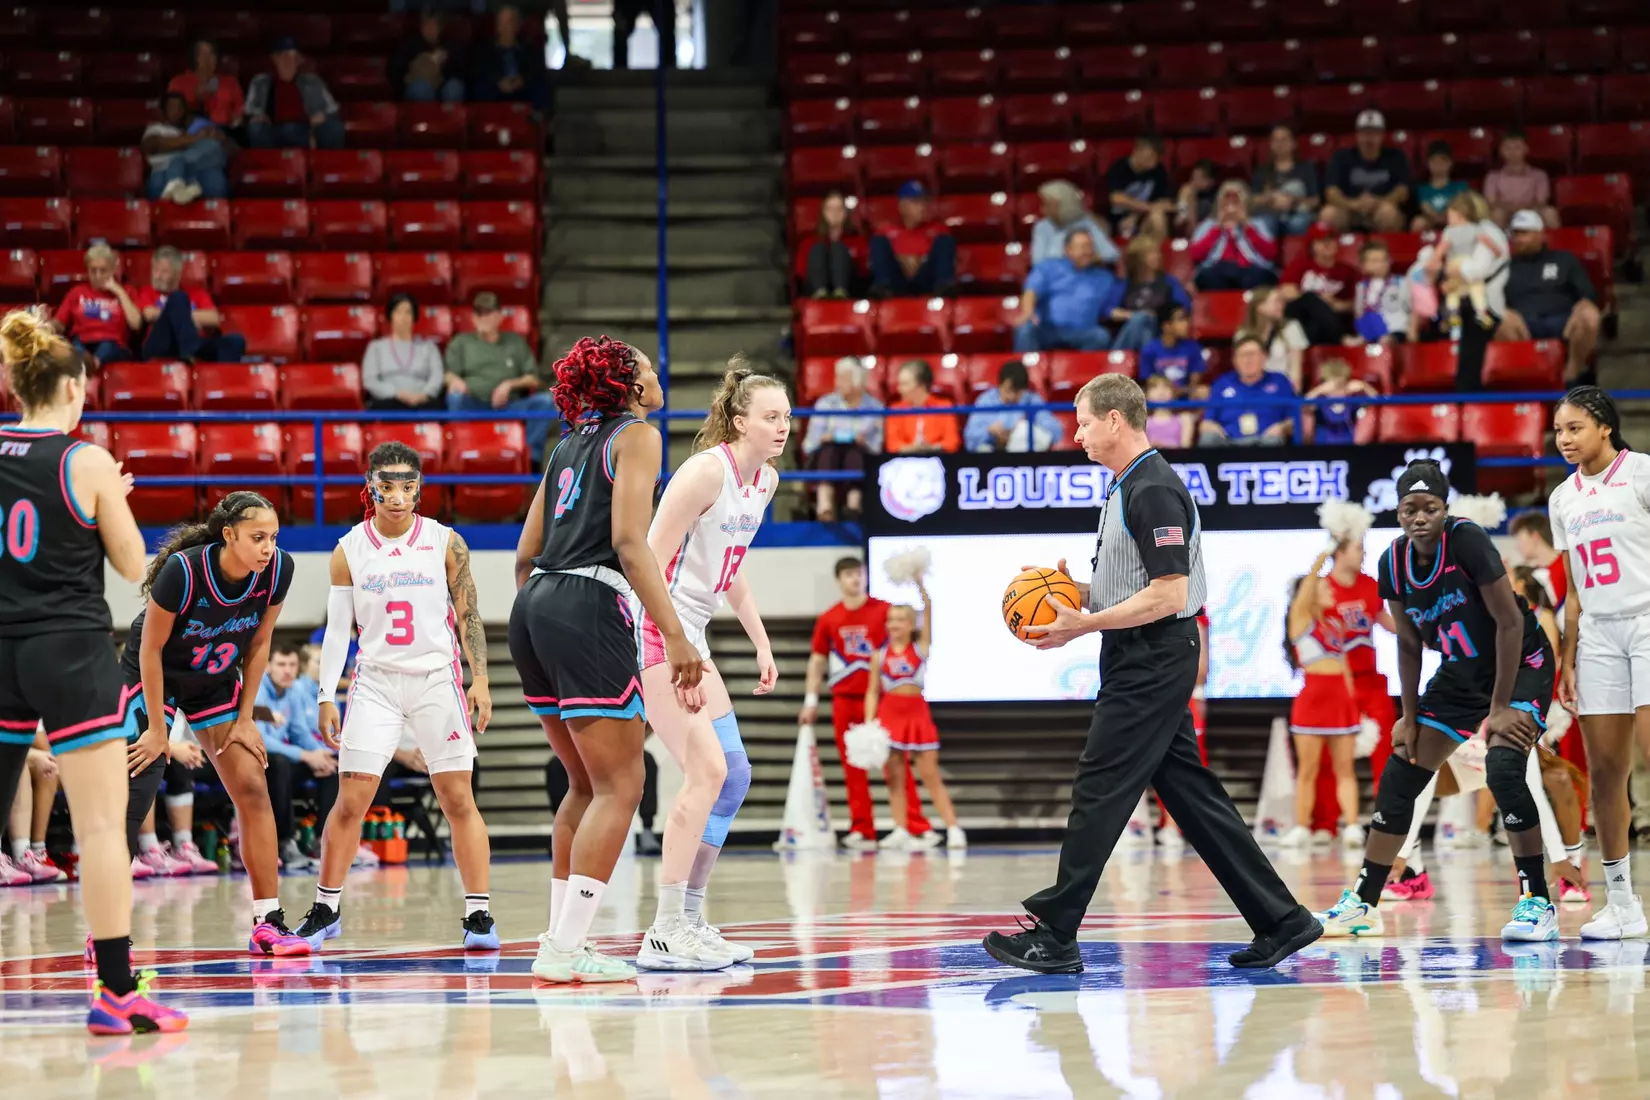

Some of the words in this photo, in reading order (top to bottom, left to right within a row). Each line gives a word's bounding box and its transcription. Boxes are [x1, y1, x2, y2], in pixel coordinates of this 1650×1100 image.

[957, 463, 1216, 510] LOUISIA
[1218, 460, 1349, 505] TECH
[0, 498, 39, 563] 0
[361, 574, 386, 594] Lady
[387, 570, 435, 588] Techsters
[1576, 537, 1622, 589] 15
[385, 600, 415, 645] 3
[190, 641, 239, 675] 13
